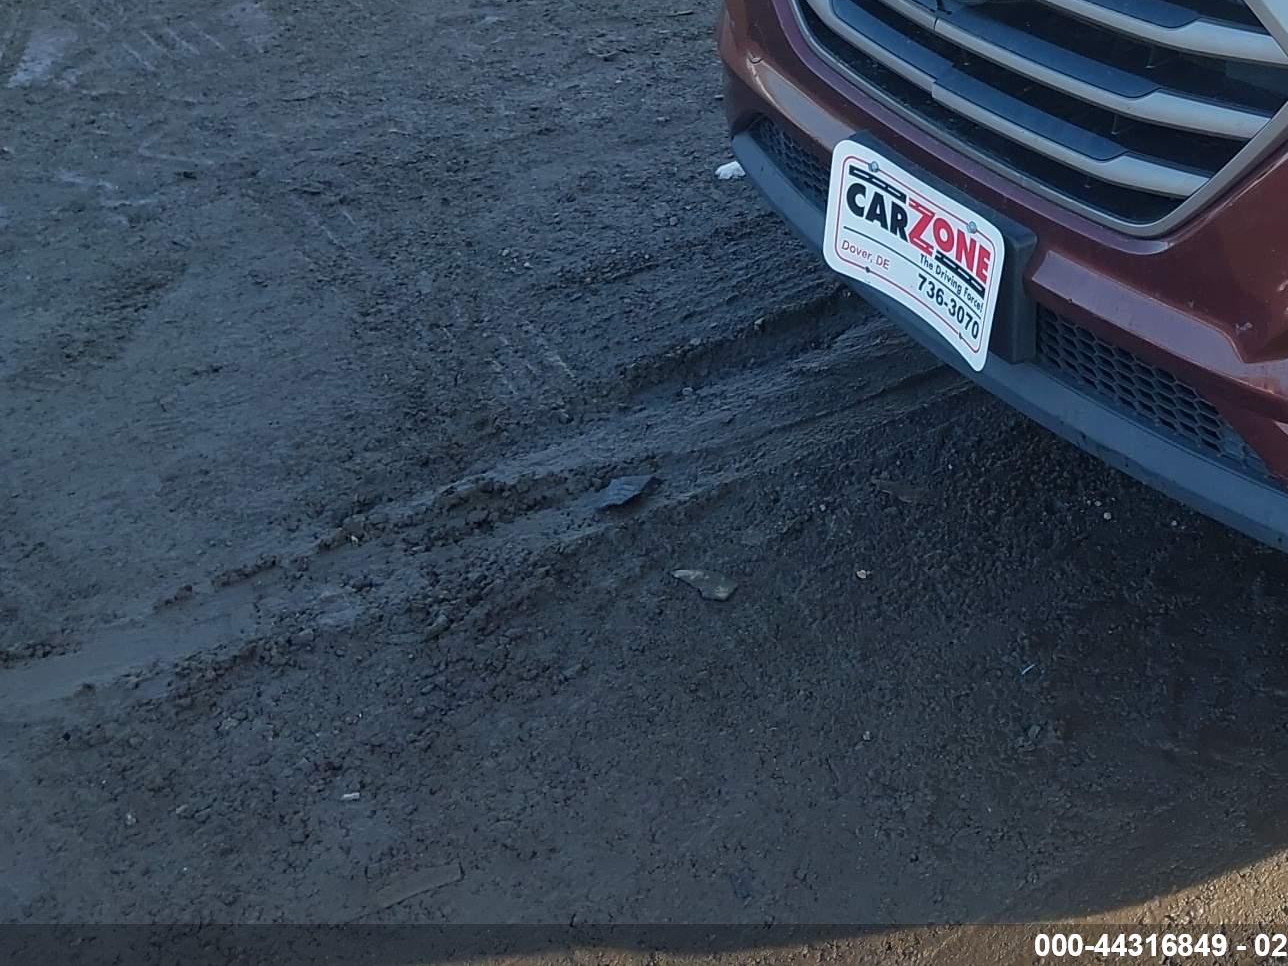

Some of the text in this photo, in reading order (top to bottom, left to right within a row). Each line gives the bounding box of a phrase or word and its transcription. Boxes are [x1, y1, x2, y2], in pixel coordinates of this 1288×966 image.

[841, 239, 891, 271] Dover, DE
[920, 253, 983, 312] The Driving Force!
[917, 273, 980, 340] 736-3070
